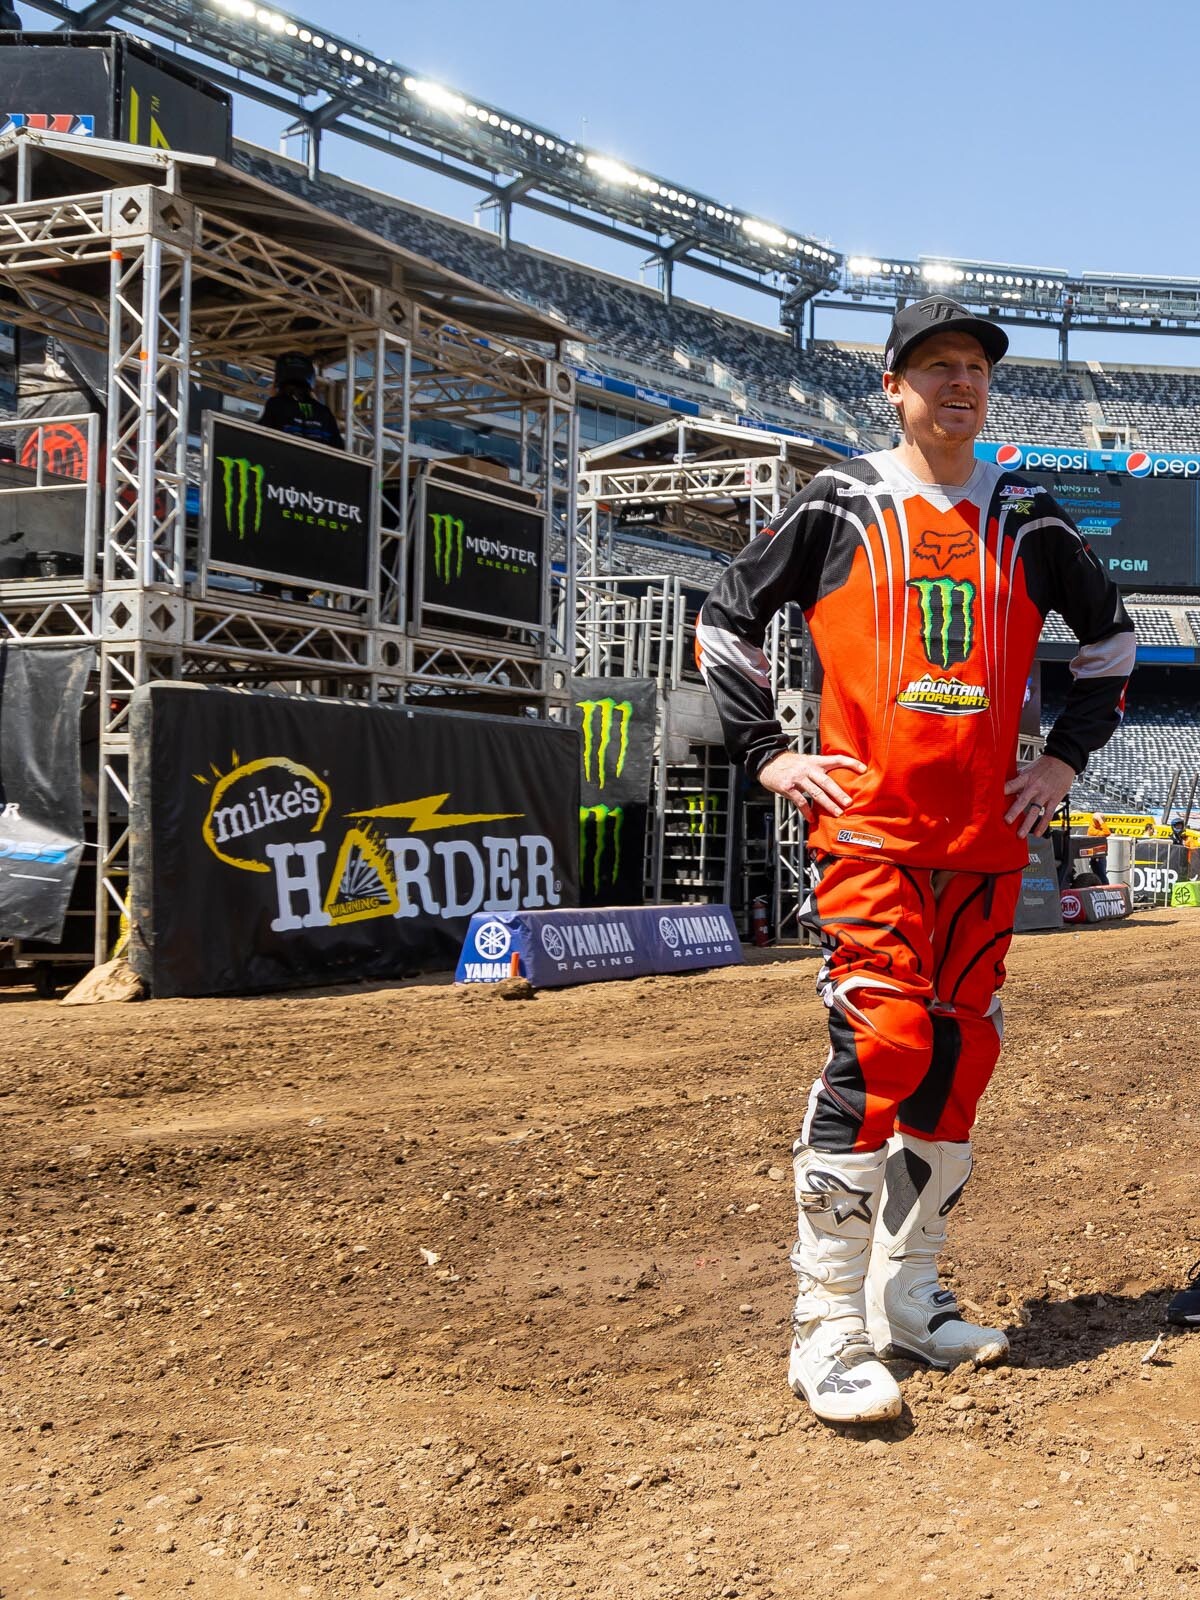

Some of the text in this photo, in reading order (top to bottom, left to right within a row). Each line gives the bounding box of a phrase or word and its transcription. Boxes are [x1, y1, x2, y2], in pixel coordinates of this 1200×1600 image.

[1025, 451, 1088, 473] pepsi
[267, 483, 362, 523] MONSTER
[281, 509, 349, 532] ENERGY
[466, 535, 538, 567] MONSTER
[477, 556, 527, 574] ENERGY
[1109, 558, 1148, 571] PGM
[906, 681, 985, 697] MOUNTAIN
[897, 692, 990, 708] MOTORSPORTS
[213, 781, 321, 843] mike's
[328, 898, 379, 918] WARNING
[560, 922, 635, 957] YAMAHA
[673, 916, 733, 945] YAMAHA
[673, 945, 733, 958] RACING
[464, 963, 514, 979] YAMAH
[557, 956, 634, 971] RACING
